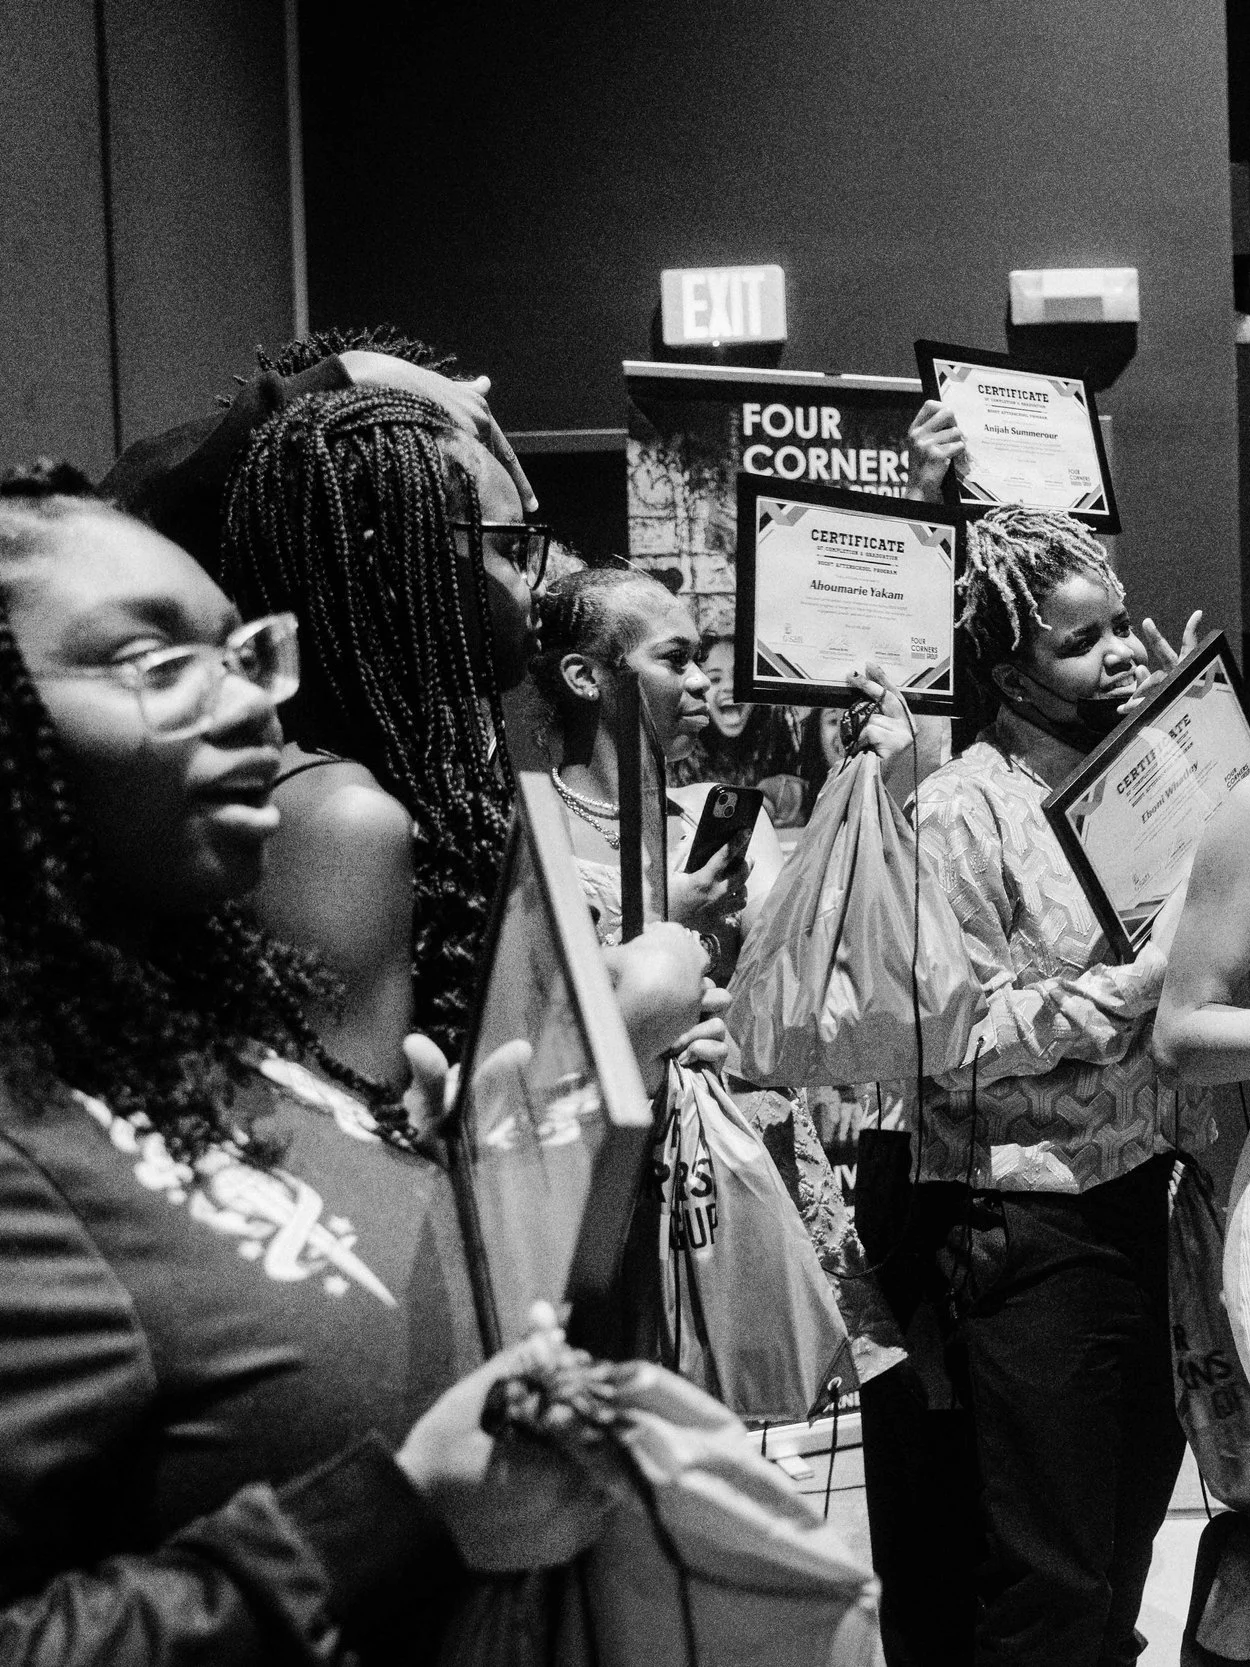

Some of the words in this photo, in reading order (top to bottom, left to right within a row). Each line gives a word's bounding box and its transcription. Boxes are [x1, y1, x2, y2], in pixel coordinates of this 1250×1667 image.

[682, 272, 765, 339] EXIT
[978, 384, 1049, 403] CERTIFICATE
[743, 403, 842, 439] FOUR
[984, 424, 1009, 434] Anijah
[1011, 427, 1058, 439] Summerour
[811, 528, 905, 553] CERTIFICATE
[810, 579, 868, 596] Ahoumarie
[870, 587, 904, 600] Yakam
